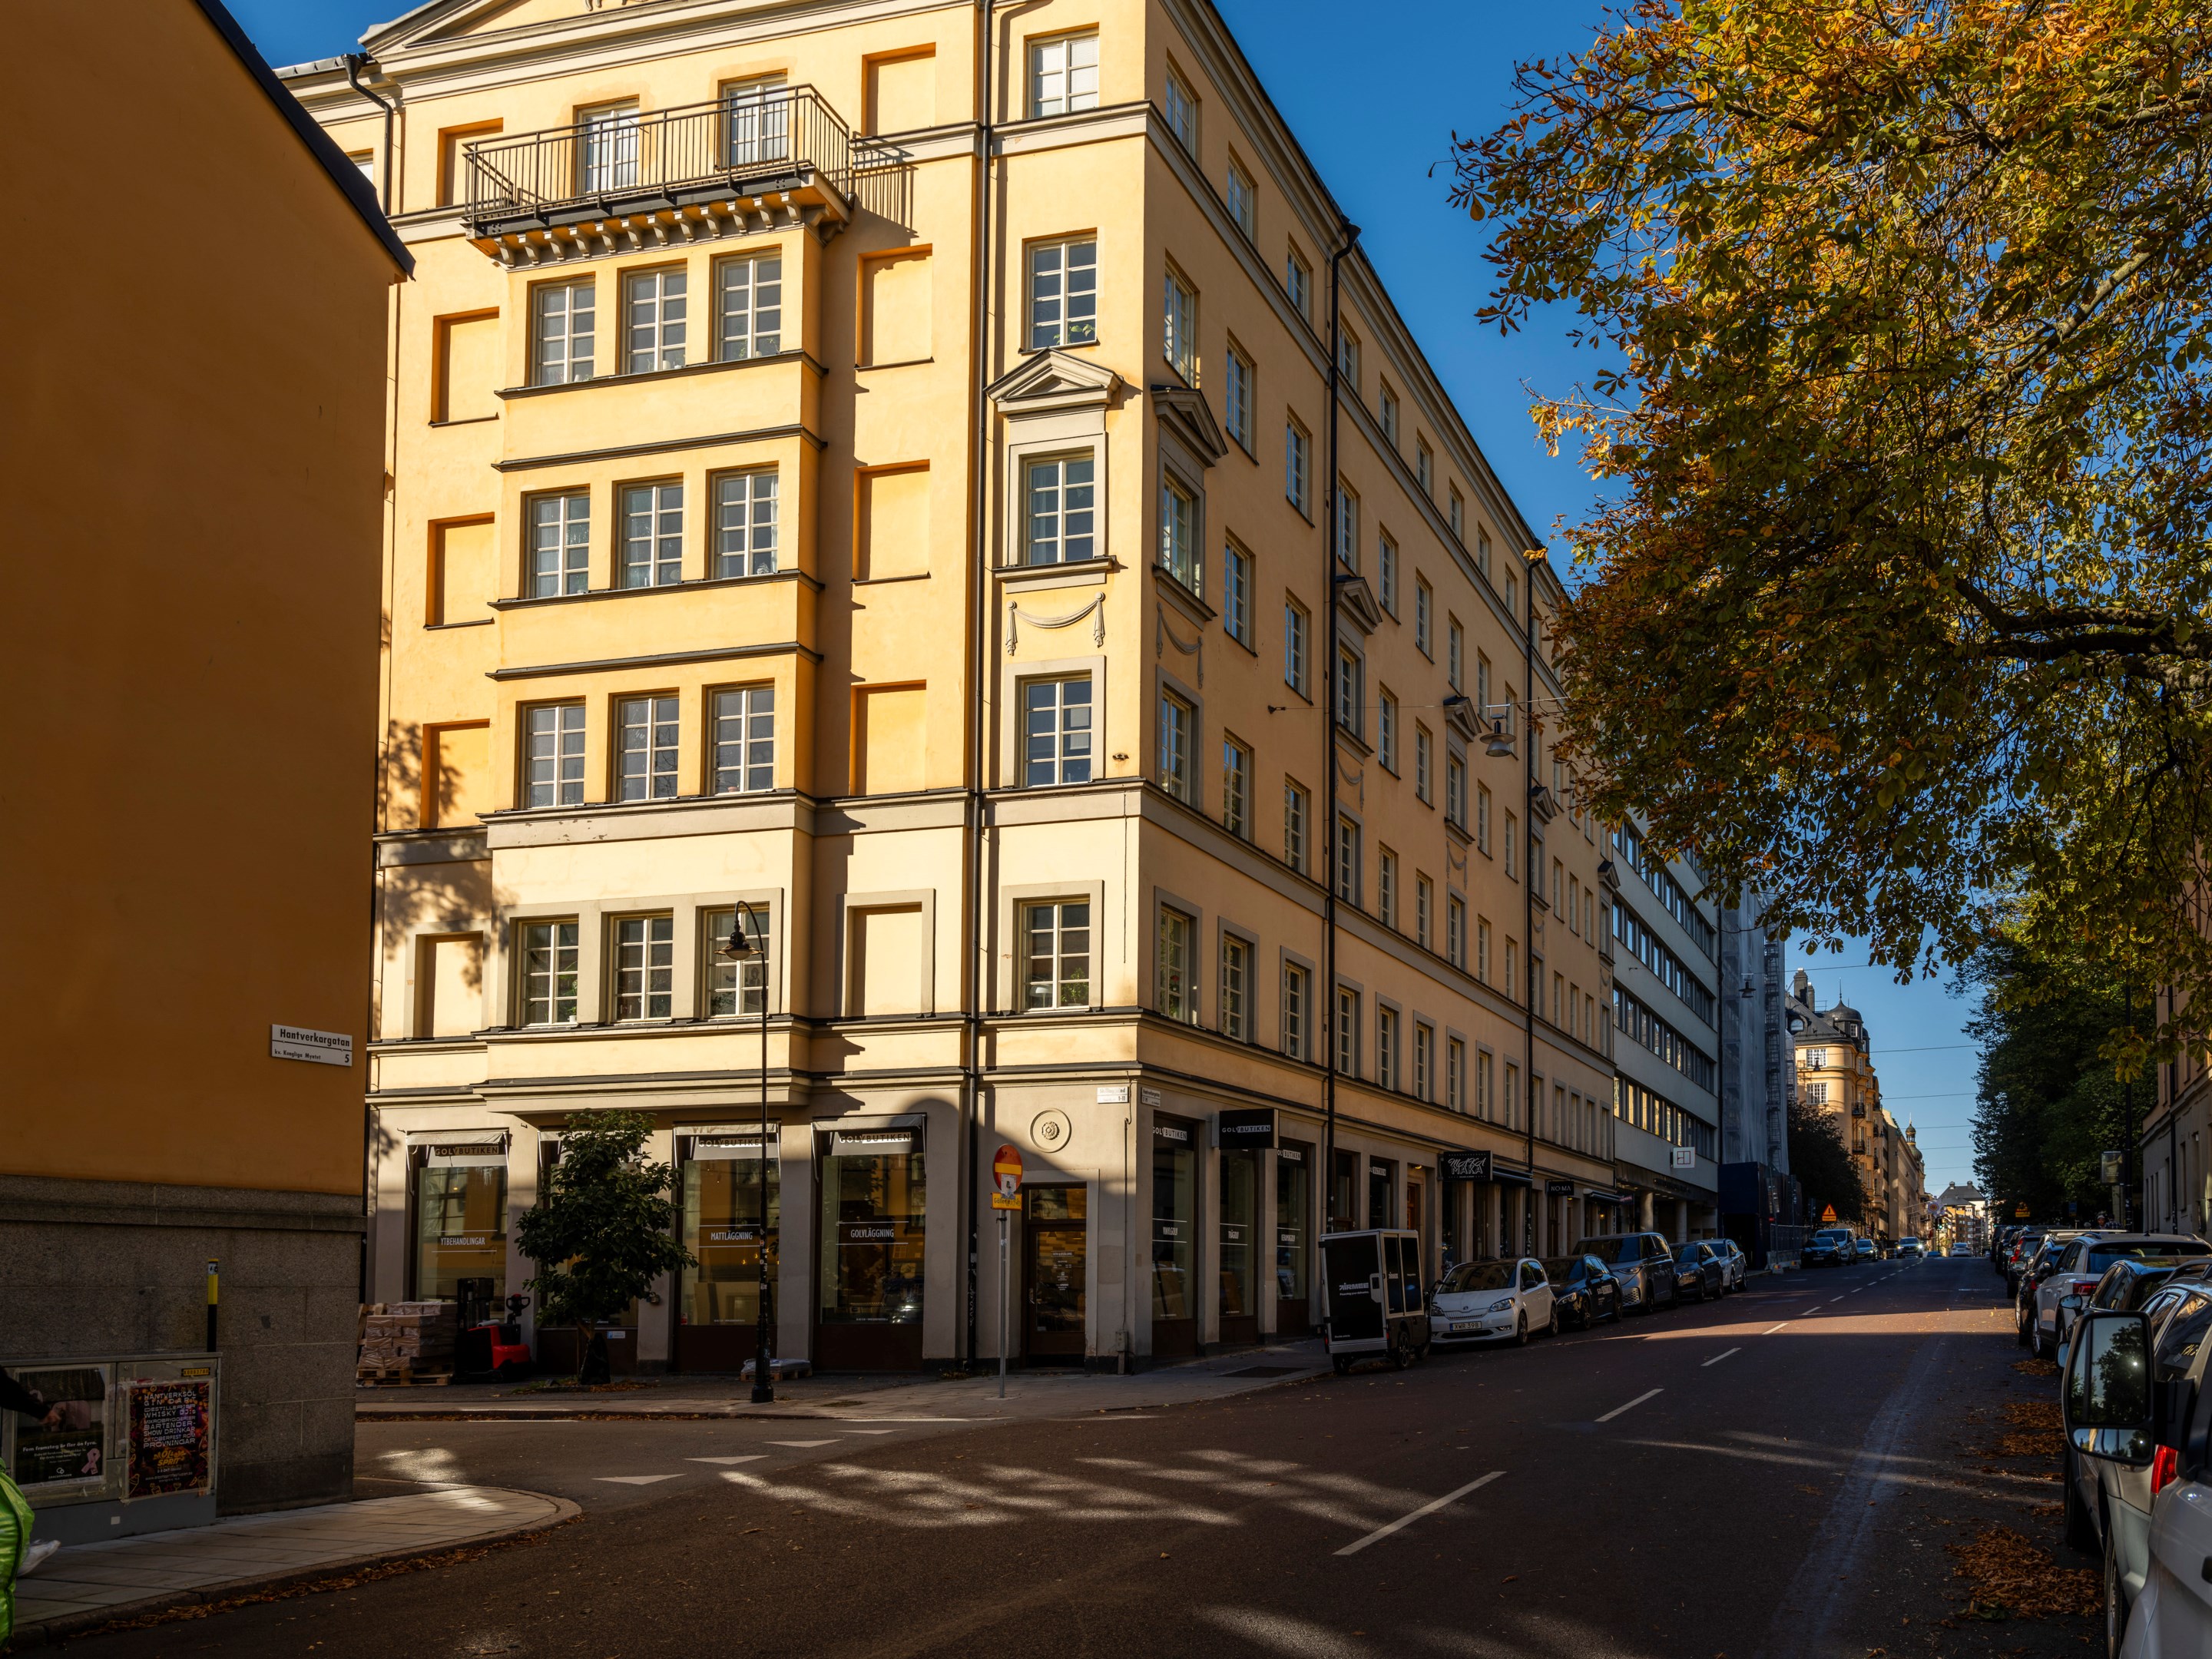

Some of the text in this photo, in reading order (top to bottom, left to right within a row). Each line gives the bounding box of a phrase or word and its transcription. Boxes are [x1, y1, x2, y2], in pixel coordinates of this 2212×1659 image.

[280, 1028, 350, 1047] Hantverkargatan
[345, 1054, 350, 1063] 5
[1153, 1126, 1187, 1140] GOLVBUTIKEN
[839, 1133, 911, 1144] GOLVBUTIKEN
[435, 1147, 498, 1156] GOLVBUTIKEN
[1277, 1149, 1301, 1160] OLVBUTIKEN
[1451, 1165, 1483, 1174] MAKA
[710, 1230, 753, 1240] MATTLÄGGNING
[850, 1227, 894, 1238] GOLVLÄGGNING
[441, 1237, 485, 1246] YTBEHANDLINGAR
[1339, 1283, 1369, 1291] AIRMEE
[144, 1410, 176, 1419] WHISKY
[144, 1421, 196, 1430] BARTENDER-
[144, 1434, 181, 1442] OKTOBERFEST
[144, 1439, 195, 1449] PROVNINGAR
[157, 1458, 180, 1466] SPRIT
